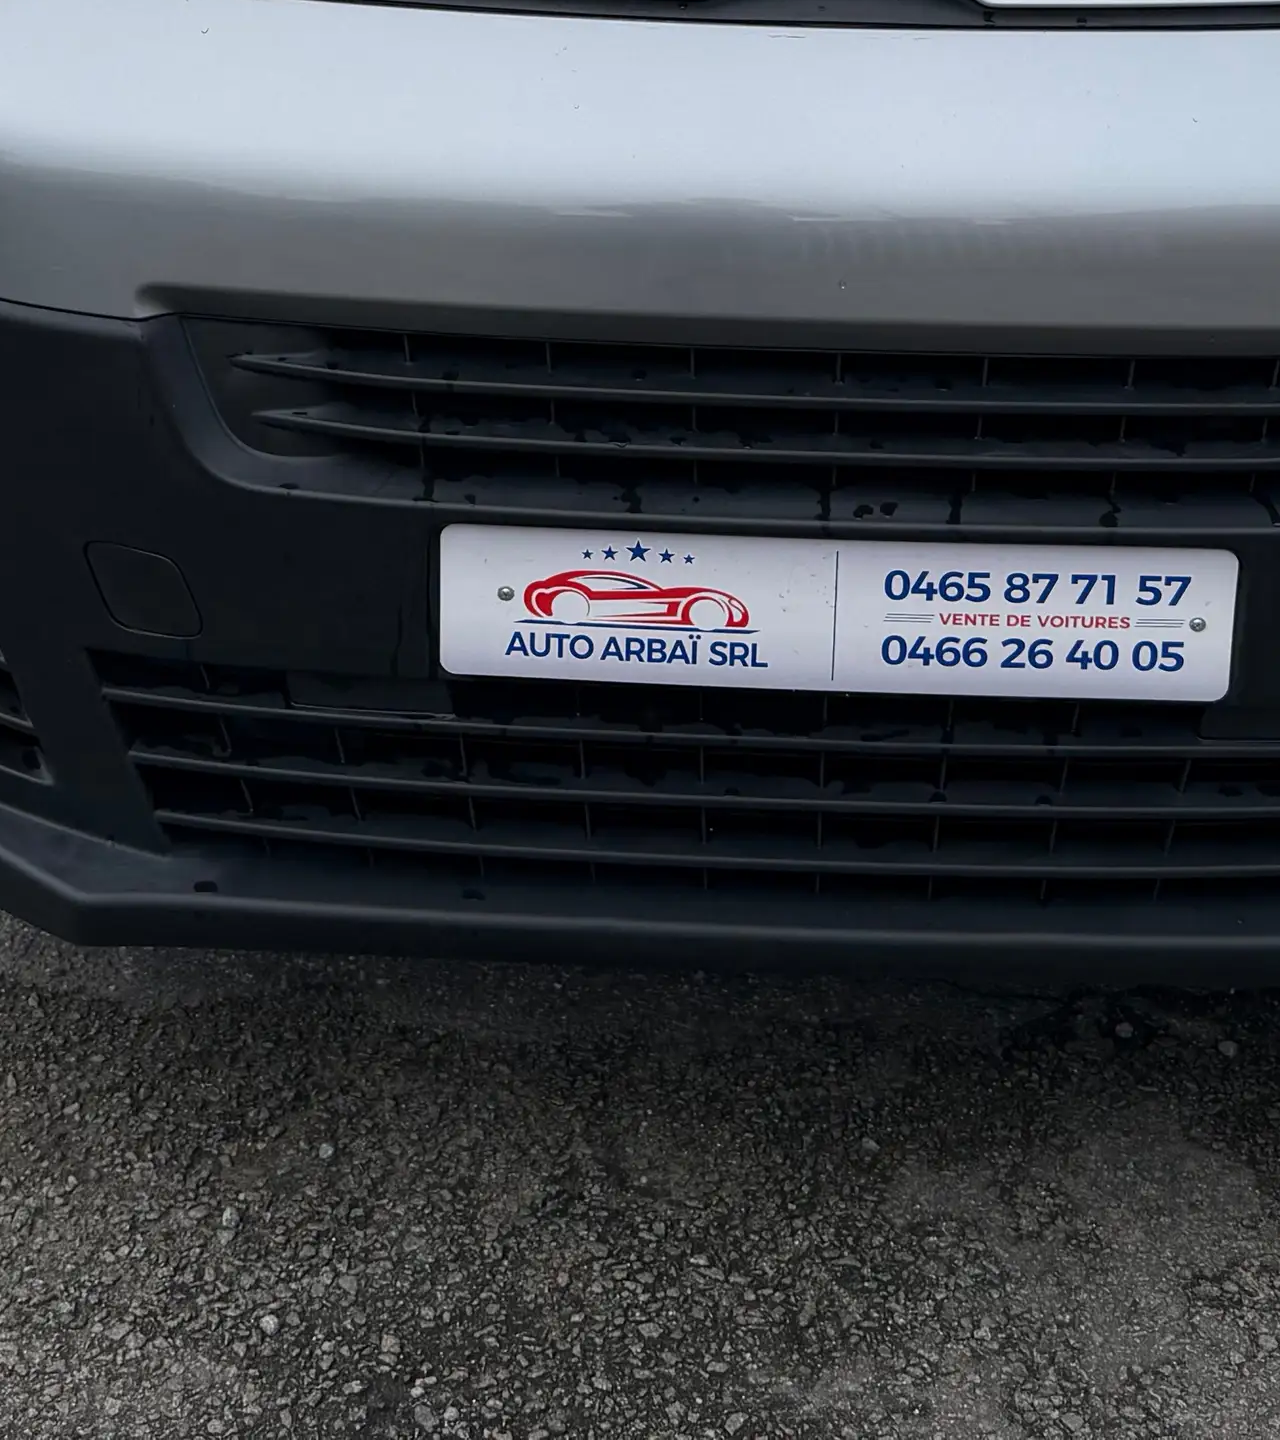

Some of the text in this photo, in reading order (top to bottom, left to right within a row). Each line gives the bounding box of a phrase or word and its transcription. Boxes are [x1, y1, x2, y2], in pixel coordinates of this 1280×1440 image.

[883, 569, 1192, 606] 0465 87 71 57
[939, 612, 1131, 629] VENTE DE VOITURES
[505, 631, 768, 668] AUTO ARBAÏ SRL
[881, 635, 1184, 672] 0466 26 40 05
